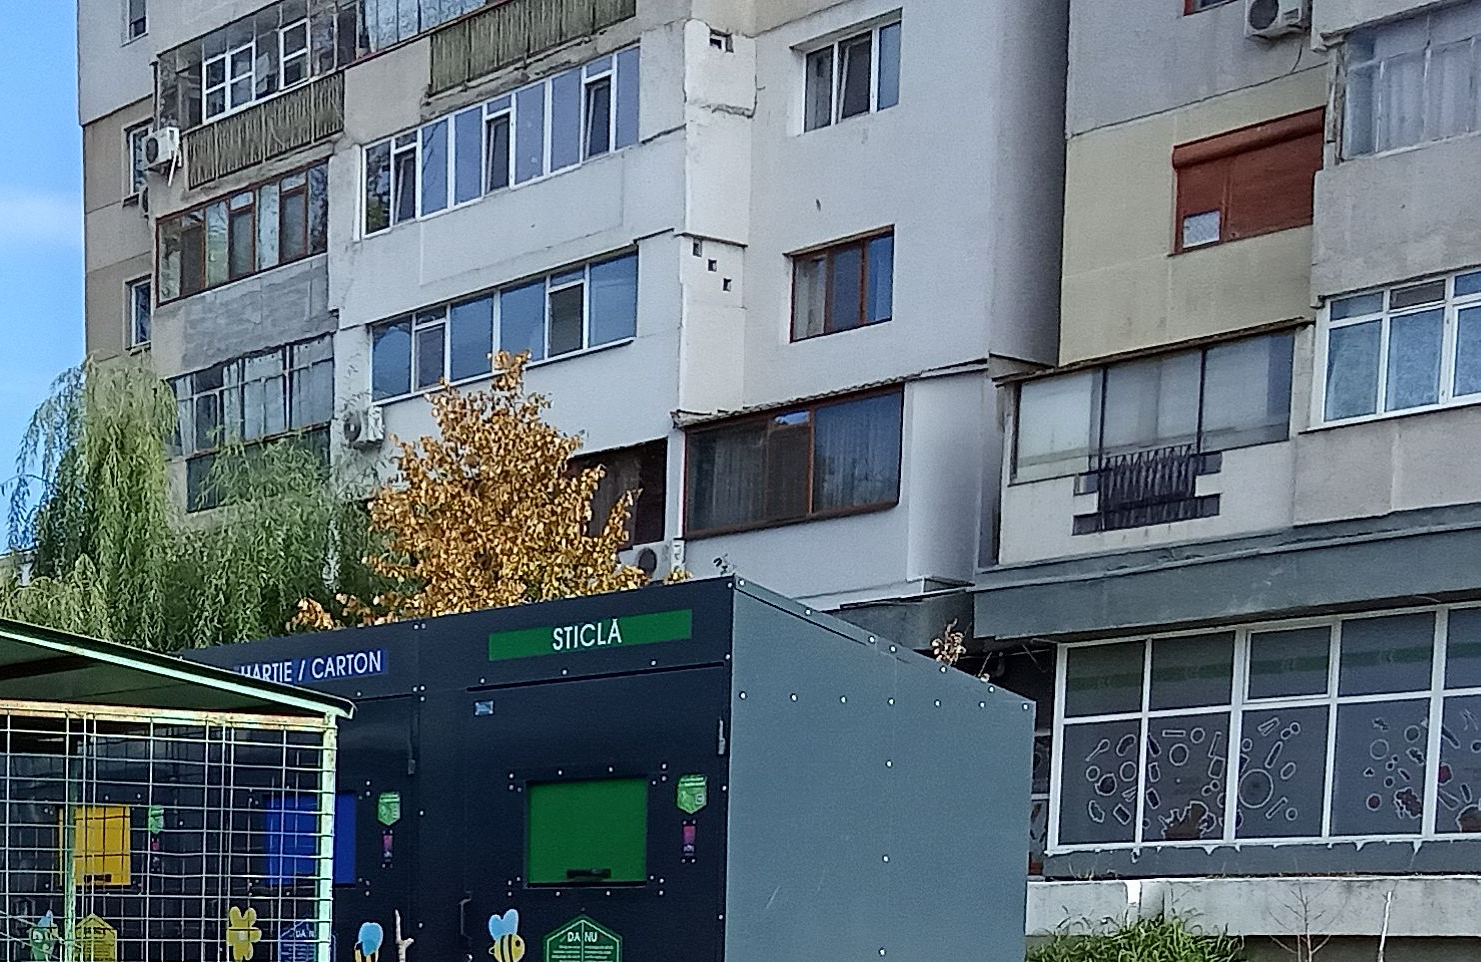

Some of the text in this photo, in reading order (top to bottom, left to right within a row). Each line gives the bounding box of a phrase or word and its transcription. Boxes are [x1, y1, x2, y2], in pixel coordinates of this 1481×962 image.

[311, 650, 382, 679] CARTON
[567, 932, 598, 943] DA NU
